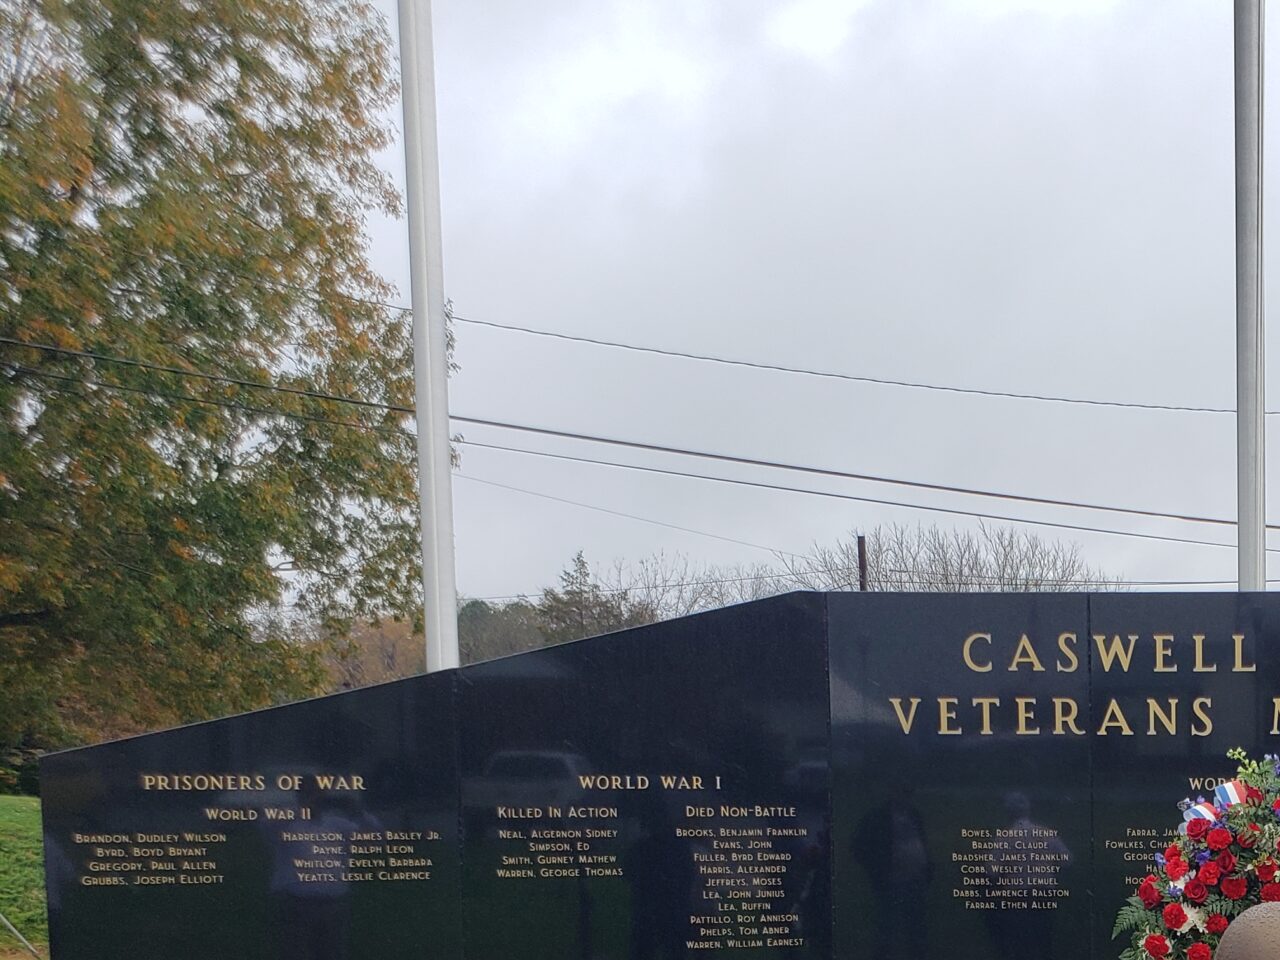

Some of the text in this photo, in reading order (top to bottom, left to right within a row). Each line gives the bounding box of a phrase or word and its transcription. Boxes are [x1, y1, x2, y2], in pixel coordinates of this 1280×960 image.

[963, 633, 1256, 672] CASWELL
[889, 698, 1212, 736] VETERANS
[144, 776, 366, 790] PRISONERS OF WAR
[579, 776, 720, 789] WORLD WAR I
[205, 808, 310, 820] WORLD WAR II
[498, 806, 618, 818] KILLED IN ACTION
[686, 806, 796, 817] DIED NON-BATTLE
[136, 832, 179, 843] DUDLEY
[183, 832, 227, 843] WILSON
[585, 828, 618, 838] SIDNEY
[719, 827, 763, 837] BENJAMIN
[766, 827, 808, 837] FRANKLIN
[350, 844, 383, 854] RALPH
[385, 844, 414, 854] LEON
[747, 840, 772, 849] JOHN
[1014, 840, 1048, 850] CLAUDE
[132, 847, 164, 857] BOYD
[168, 846, 207, 857] BRYANT
[151, 860, 177, 871] PAUL
[182, 860, 216, 870] ALLEN
[736, 864, 787, 874] ALEXANDER
[991, 864, 1024, 874] WESLEY
[339, 871, 374, 882] LESLIE
[378, 871, 431, 881] CLARENCE
[539, 867, 580, 878] GEORGE
[584, 867, 624, 877] THOMAS
[985, 889, 1028, 898] LAWRENCE
[1032, 888, 1070, 897] RALSTON
[741, 901, 771, 911] RUFFIN
[1031, 900, 1058, 909] ALLEN
[738, 926, 759, 936] TOM
[762, 926, 790, 935] ABNER
